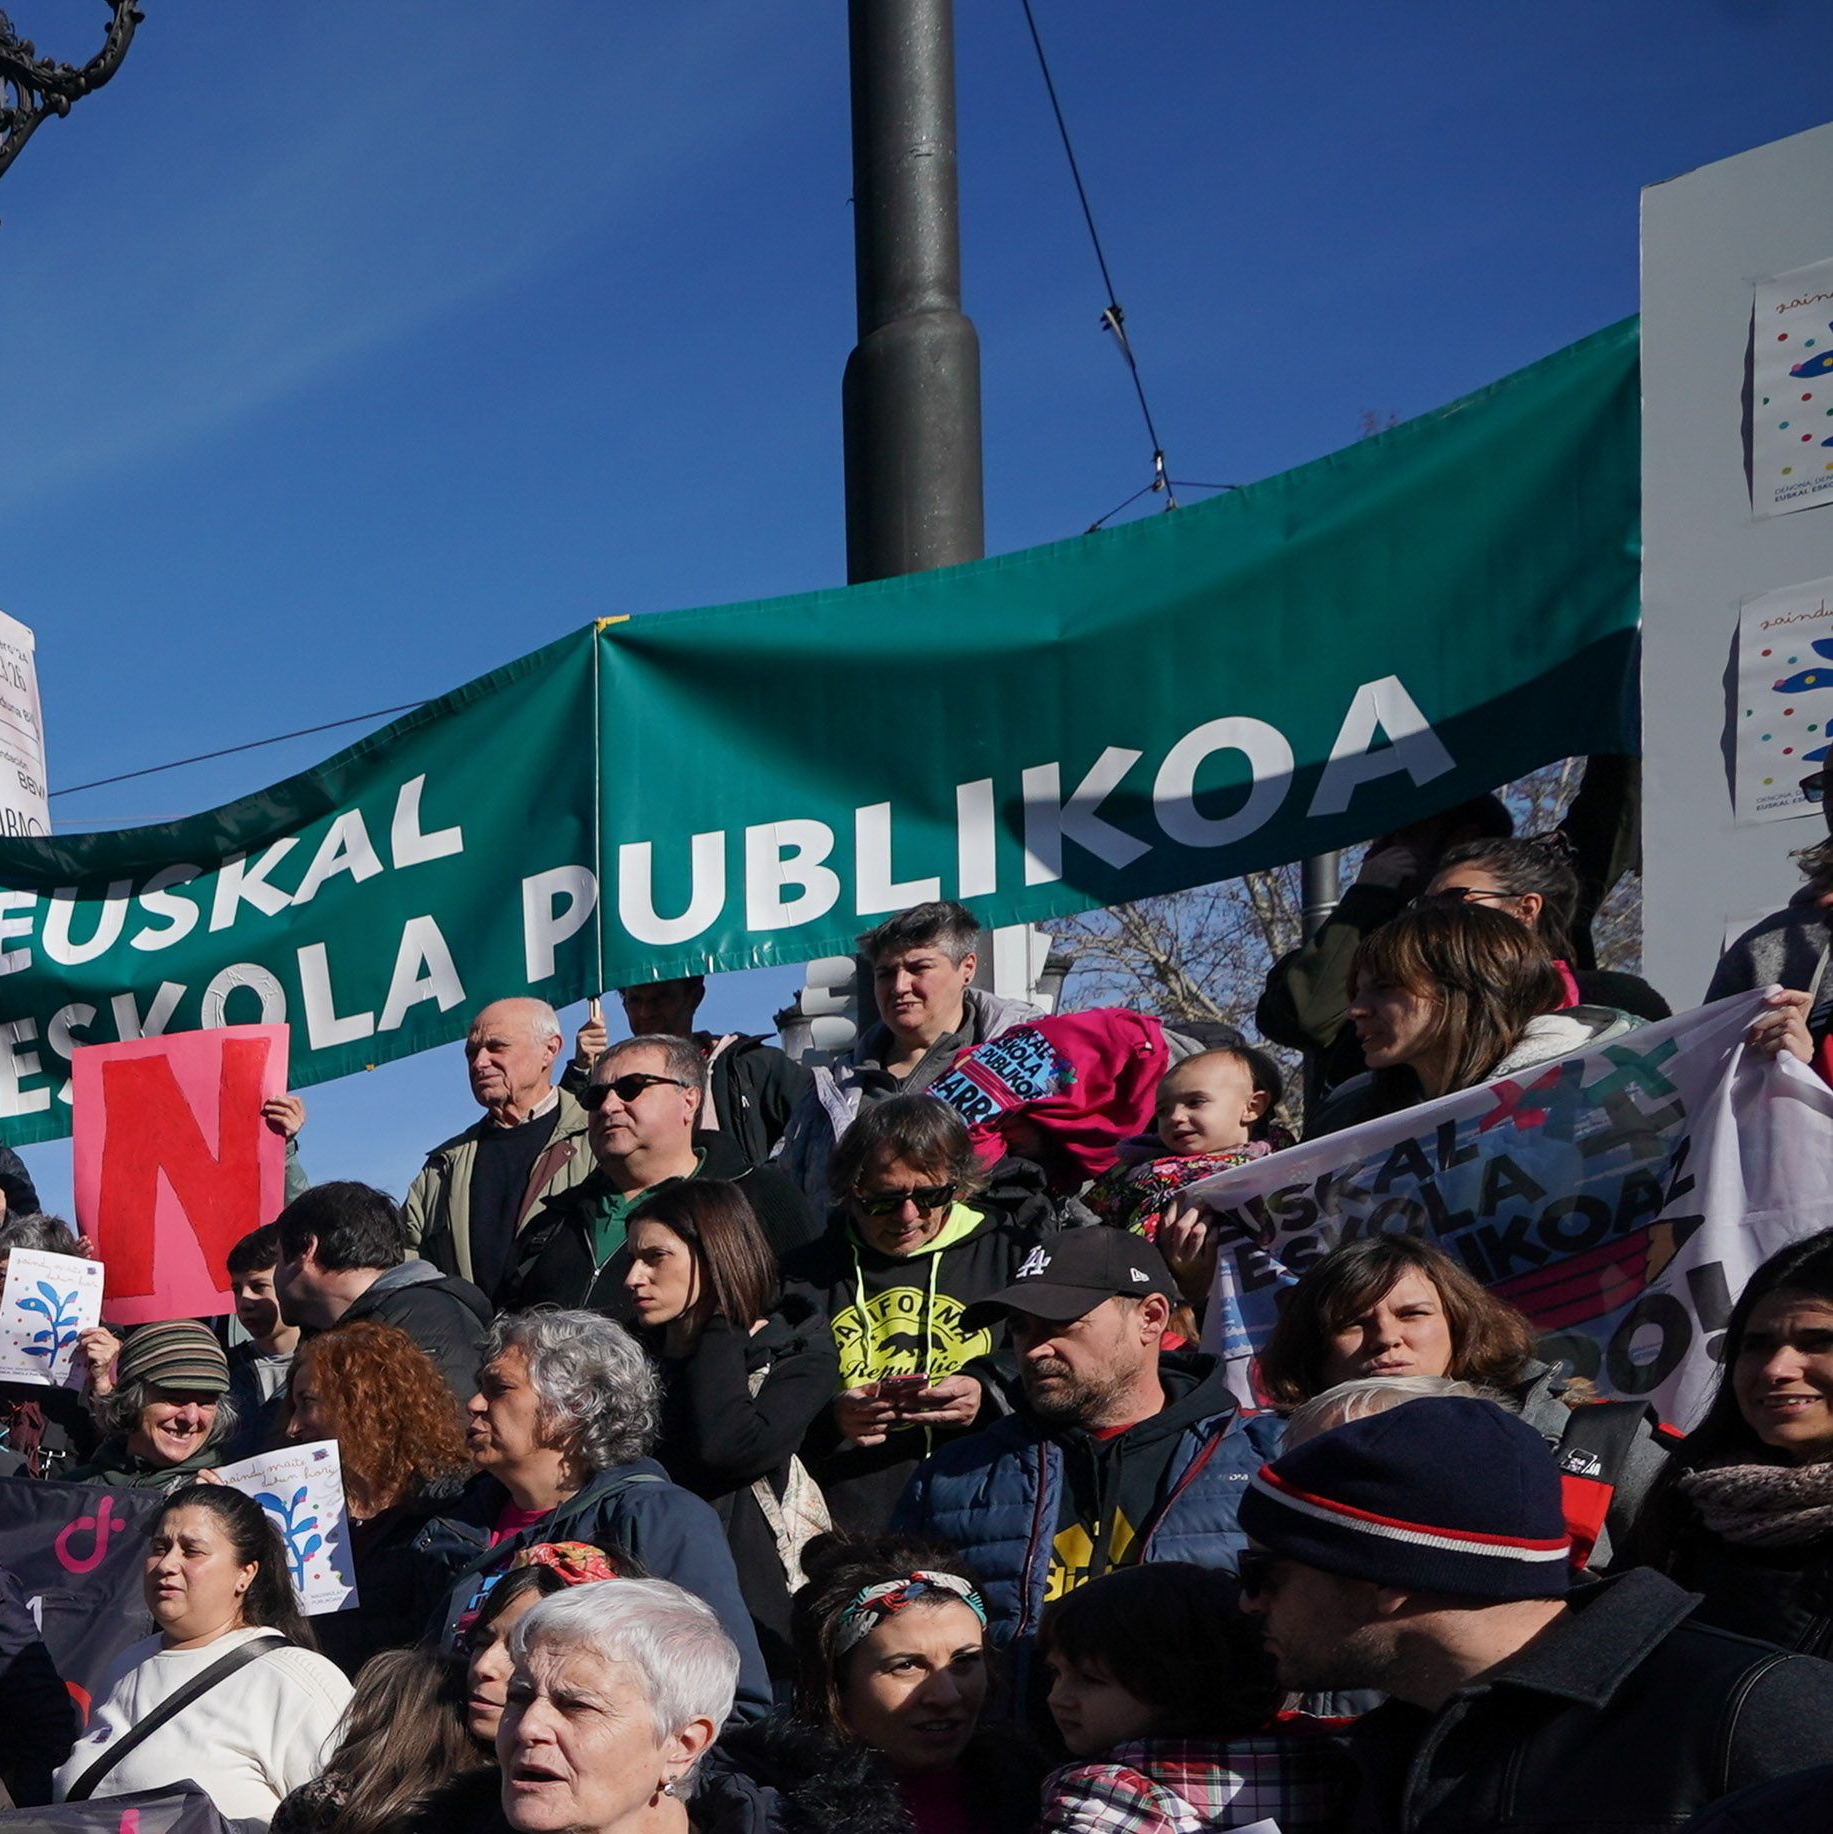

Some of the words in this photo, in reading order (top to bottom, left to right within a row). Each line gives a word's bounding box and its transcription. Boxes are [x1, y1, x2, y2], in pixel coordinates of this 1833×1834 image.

[1774, 488, 1809, 504] EUSKAL
[521, 673, 1458, 985] PUBLIKOA
[1015, 1245, 1053, 1279] LA
